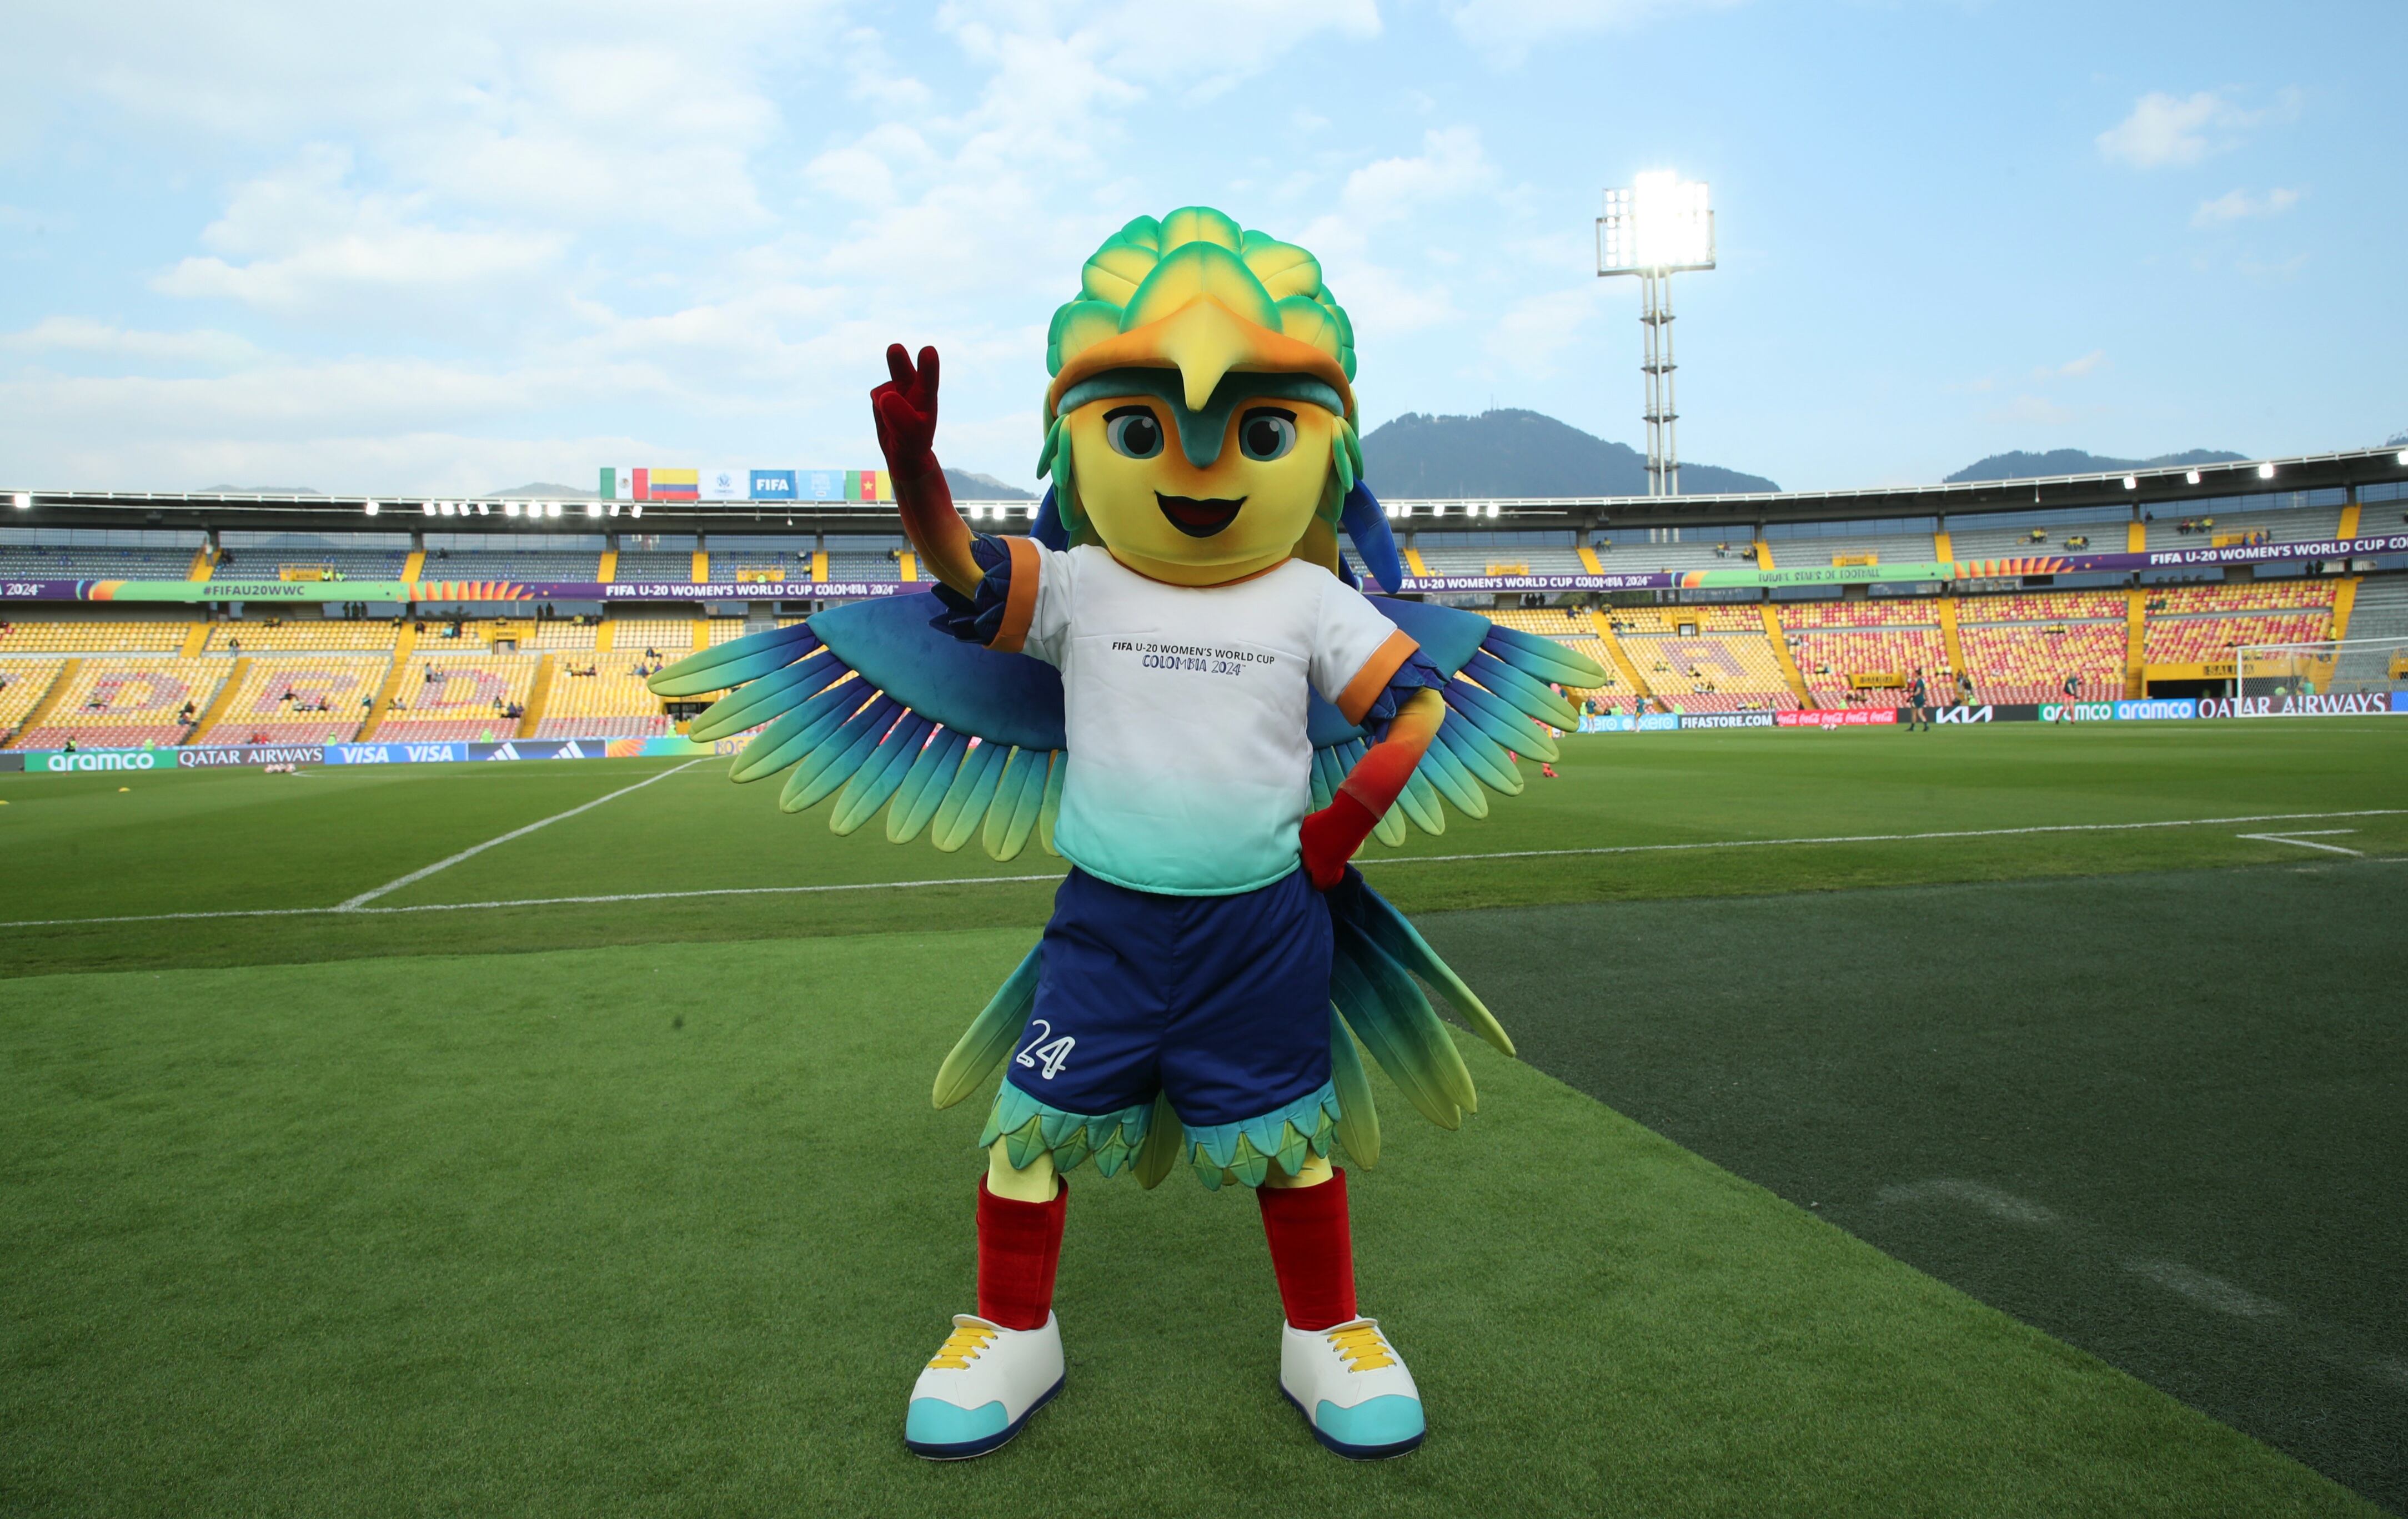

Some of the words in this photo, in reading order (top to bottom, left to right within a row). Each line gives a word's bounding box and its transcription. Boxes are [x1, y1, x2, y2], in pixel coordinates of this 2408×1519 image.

[756, 479, 789, 491] FIFA
[2150, 552, 2183, 565] FIFA
[2185, 550, 2218, 562] U-20
[2219, 545, 2291, 560] WOMEN'S
[2294, 541, 2350, 556] WORLD
[2354, 539, 2385, 551] CUP
[2389, 537, 2408, 549] CO
[1399, 578, 1417, 590] FA
[1419, 578, 1445, 589] U-20
[1447, 577, 1503, 589] WOMEN'S
[1503, 577, 1548, 589] WORLD
[1549, 576, 1573, 587] CUP
[1575, 576, 1623, 588] COLOMBIA
[1794, 571, 1822, 581] STARS
[1825, 570, 1835, 580] OF
[203, 585, 305, 596] #FIFAU20WWC
[606, 585, 636, 597] FIFA
[639, 585, 669, 596] U-20
[670, 585, 734, 596] WOMEN'S
[736, 585, 784, 596] WORLD
[786, 584, 812, 595] CUP
[815, 584, 867, 596] COLOMBIA
[1112, 641, 1133, 651] FIFA
[1135, 642, 1158, 653] U-20
[1160, 644, 1212, 657] WOMEN'S
[1215, 648, 1254, 662] WORLD
[1256, 654, 1275, 665] CUP
[1142, 654, 1207, 672] COLOMBIA
[2118, 700, 2193, 720] aramco
[2282, 692, 2386, 713] AIRWAYS
[1638, 716, 1674, 731] xero
[1682, 714, 1772, 728] FIFASTORE.COM
[1777, 713, 1798, 725] Coca-Cola
[1799, 712, 1820, 724] Coca-Cola
[1821, 712, 1844, 723] Coca-Cola
[1845, 711, 1868, 723] Coca-Cola
[1869, 711, 1894, 723] Coca-Cola
[339, 746, 390, 764] VISA
[404, 745, 454, 762] VISA
[714, 740, 753, 756] BOG
[48, 752, 154, 772] aramco
[179, 750, 241, 767] QATAR
[248, 747, 323, 763] AIRWAYS
[1016, 1019, 1076, 1080] 24
